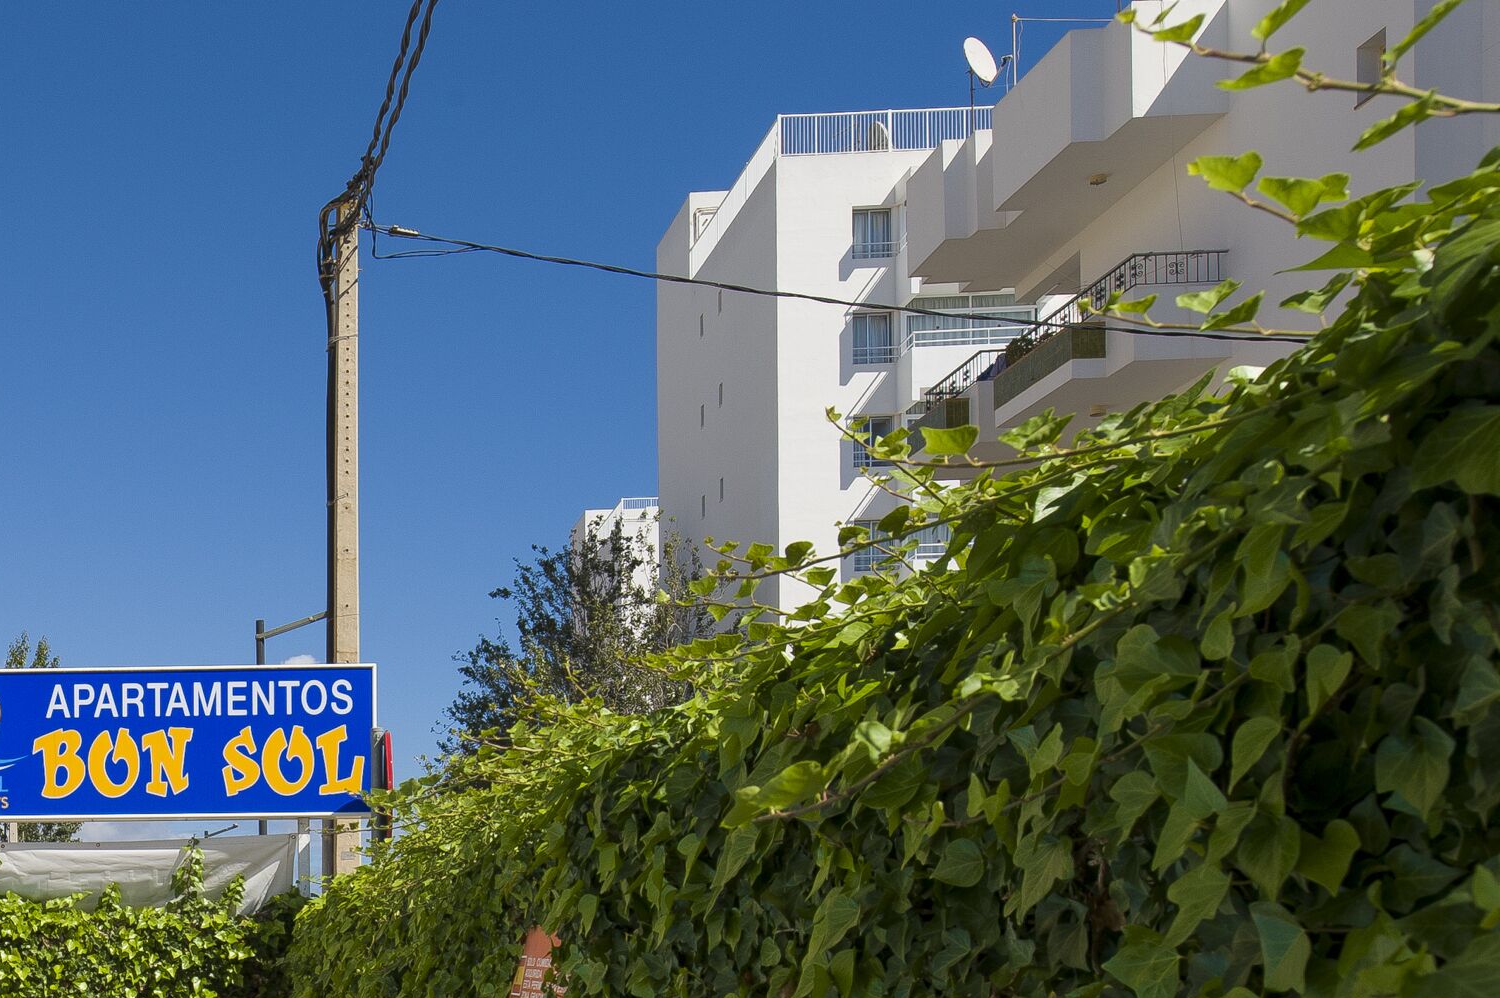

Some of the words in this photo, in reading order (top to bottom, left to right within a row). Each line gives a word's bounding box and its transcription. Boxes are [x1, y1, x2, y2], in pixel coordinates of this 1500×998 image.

[46, 679, 354, 719] APARTAMENTOS
[32, 727, 194, 799] BON
[221, 725, 366, 797] SOL
